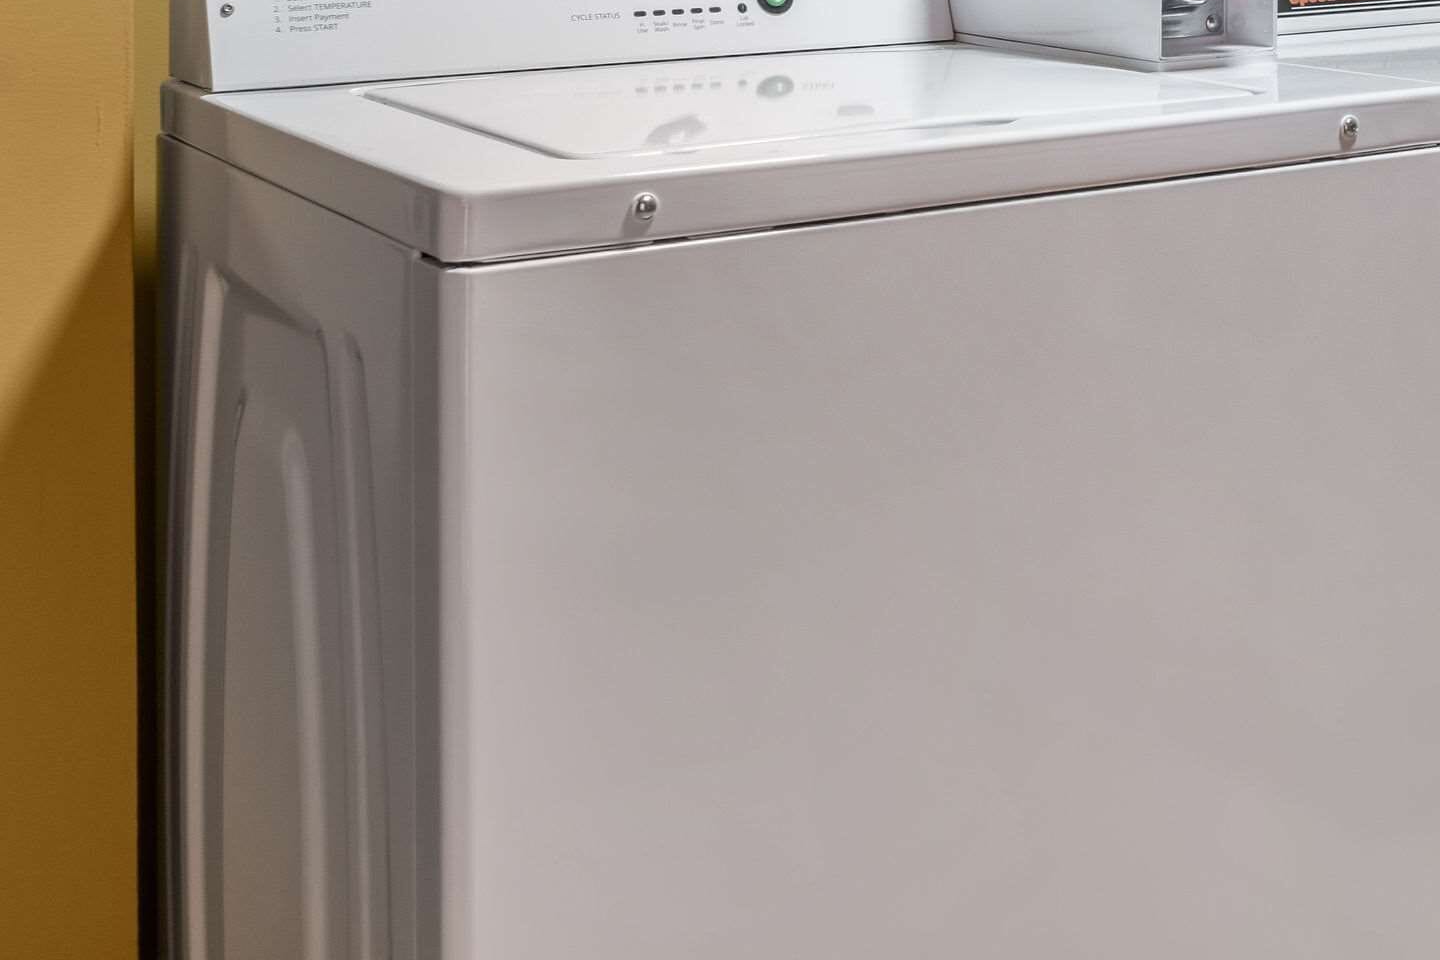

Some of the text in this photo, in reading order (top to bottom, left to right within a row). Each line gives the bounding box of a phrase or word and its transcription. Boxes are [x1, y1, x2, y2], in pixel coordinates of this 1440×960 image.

[287, 3, 312, 12] Select
[313, 1, 372, 11] TEMPERATURE
[314, 13, 349, 23] Payment
[571, 11, 621, 22] CYCLE STATUS
[289, 24, 313, 32] Press
[313, 23, 338, 31] START
